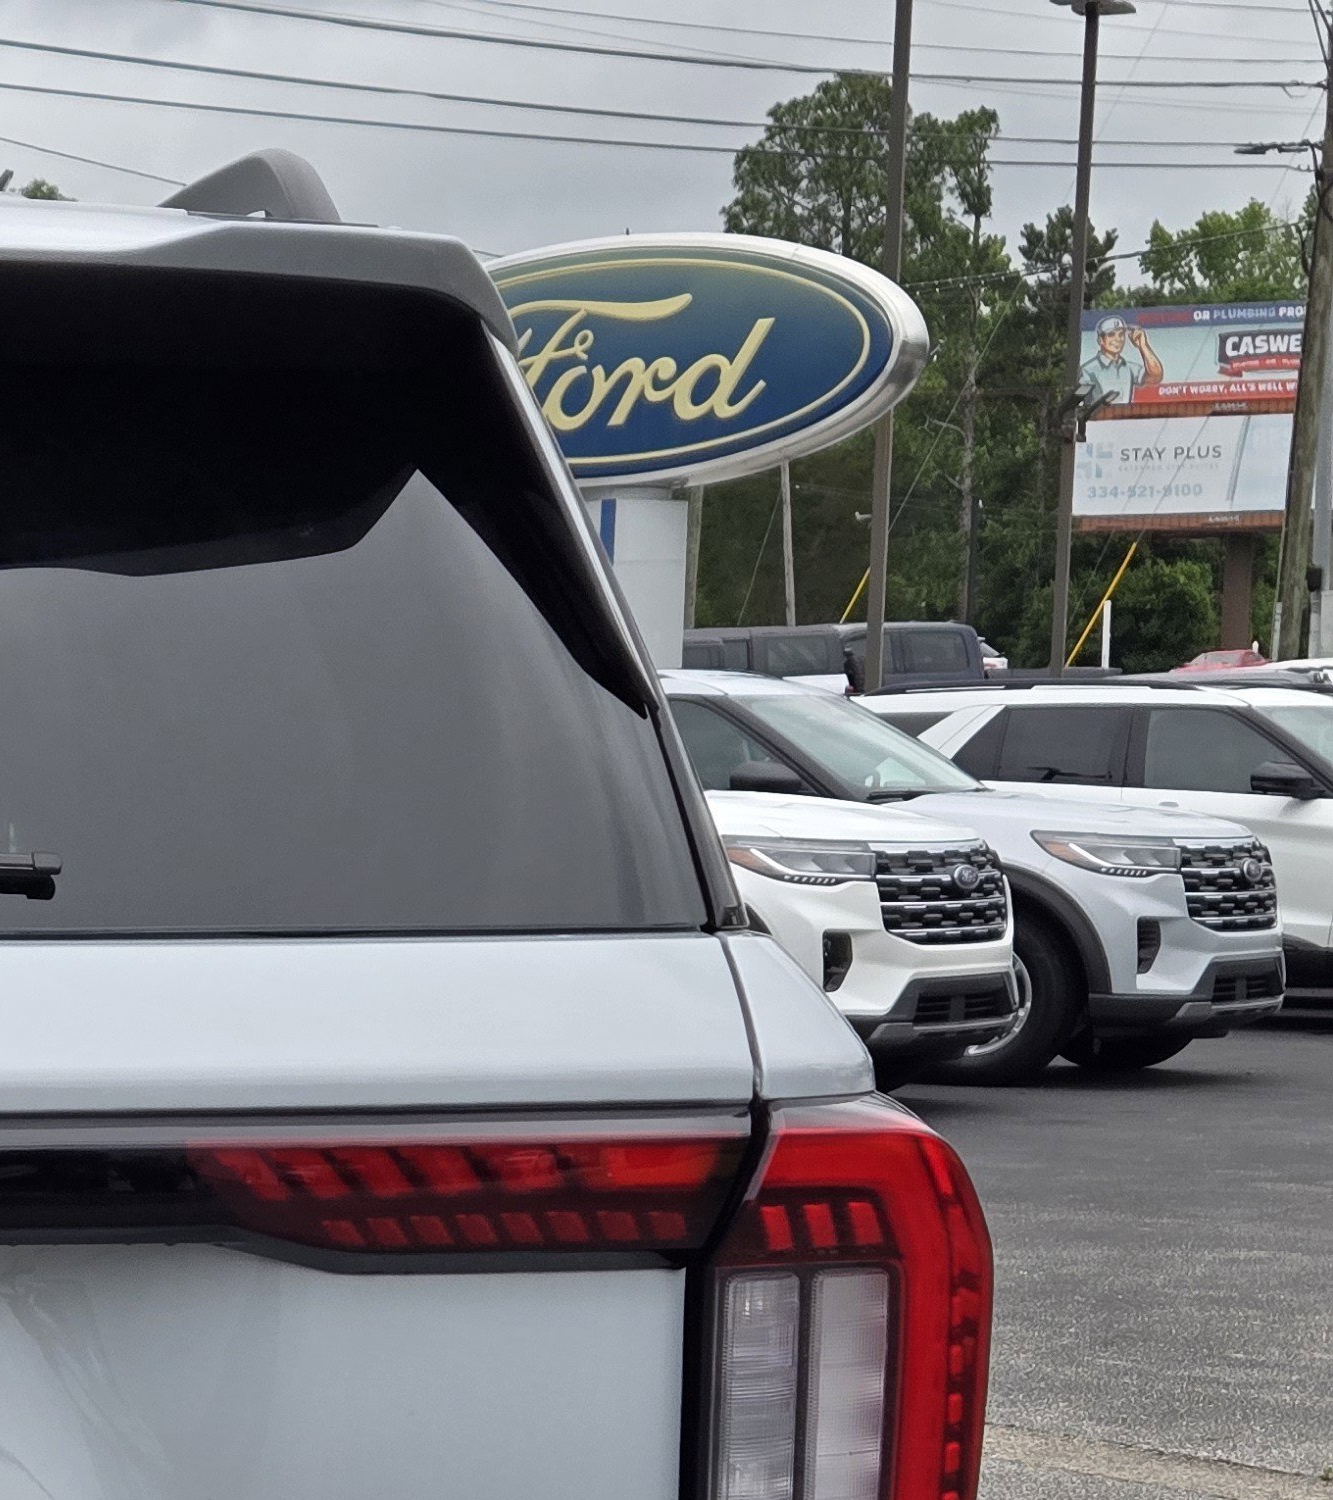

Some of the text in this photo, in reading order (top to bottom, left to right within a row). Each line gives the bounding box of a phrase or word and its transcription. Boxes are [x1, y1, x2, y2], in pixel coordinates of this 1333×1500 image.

[1194, 310, 1210, 320] OR
[1213, 306, 1276, 319] PLUMBING
[1225, 332, 1302, 357] CASWE
[508, 293, 776, 431] Ford
[1158, 385, 1187, 395] DON'T
[1230, 382, 1256, 393] ALL'S
[1258, 382, 1283, 392] WELL
[1120, 444, 1222, 461] STAY PLUS
